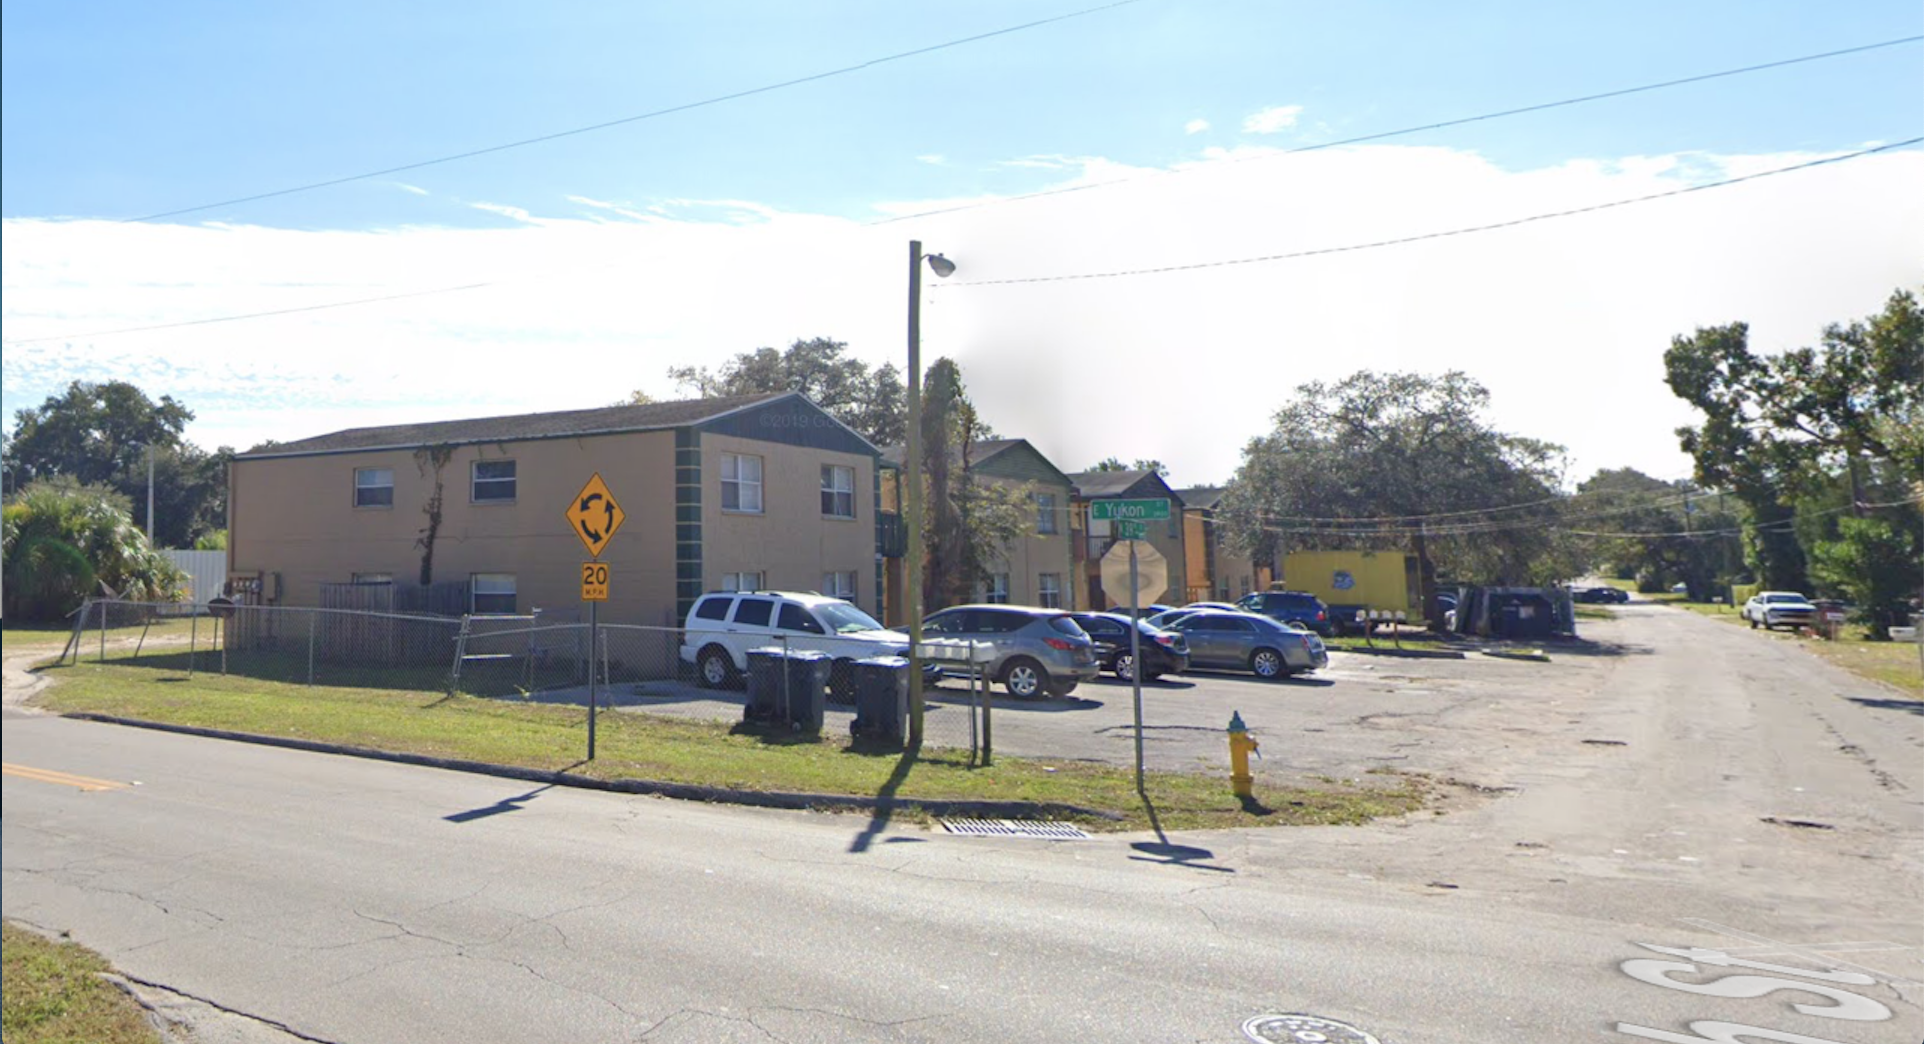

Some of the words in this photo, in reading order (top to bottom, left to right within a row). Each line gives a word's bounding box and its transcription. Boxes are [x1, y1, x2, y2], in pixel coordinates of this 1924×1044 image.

[1093, 504, 1099, 517] E
[1105, 502, 1145, 517] Yukon
[584, 566, 607, 585] 20
